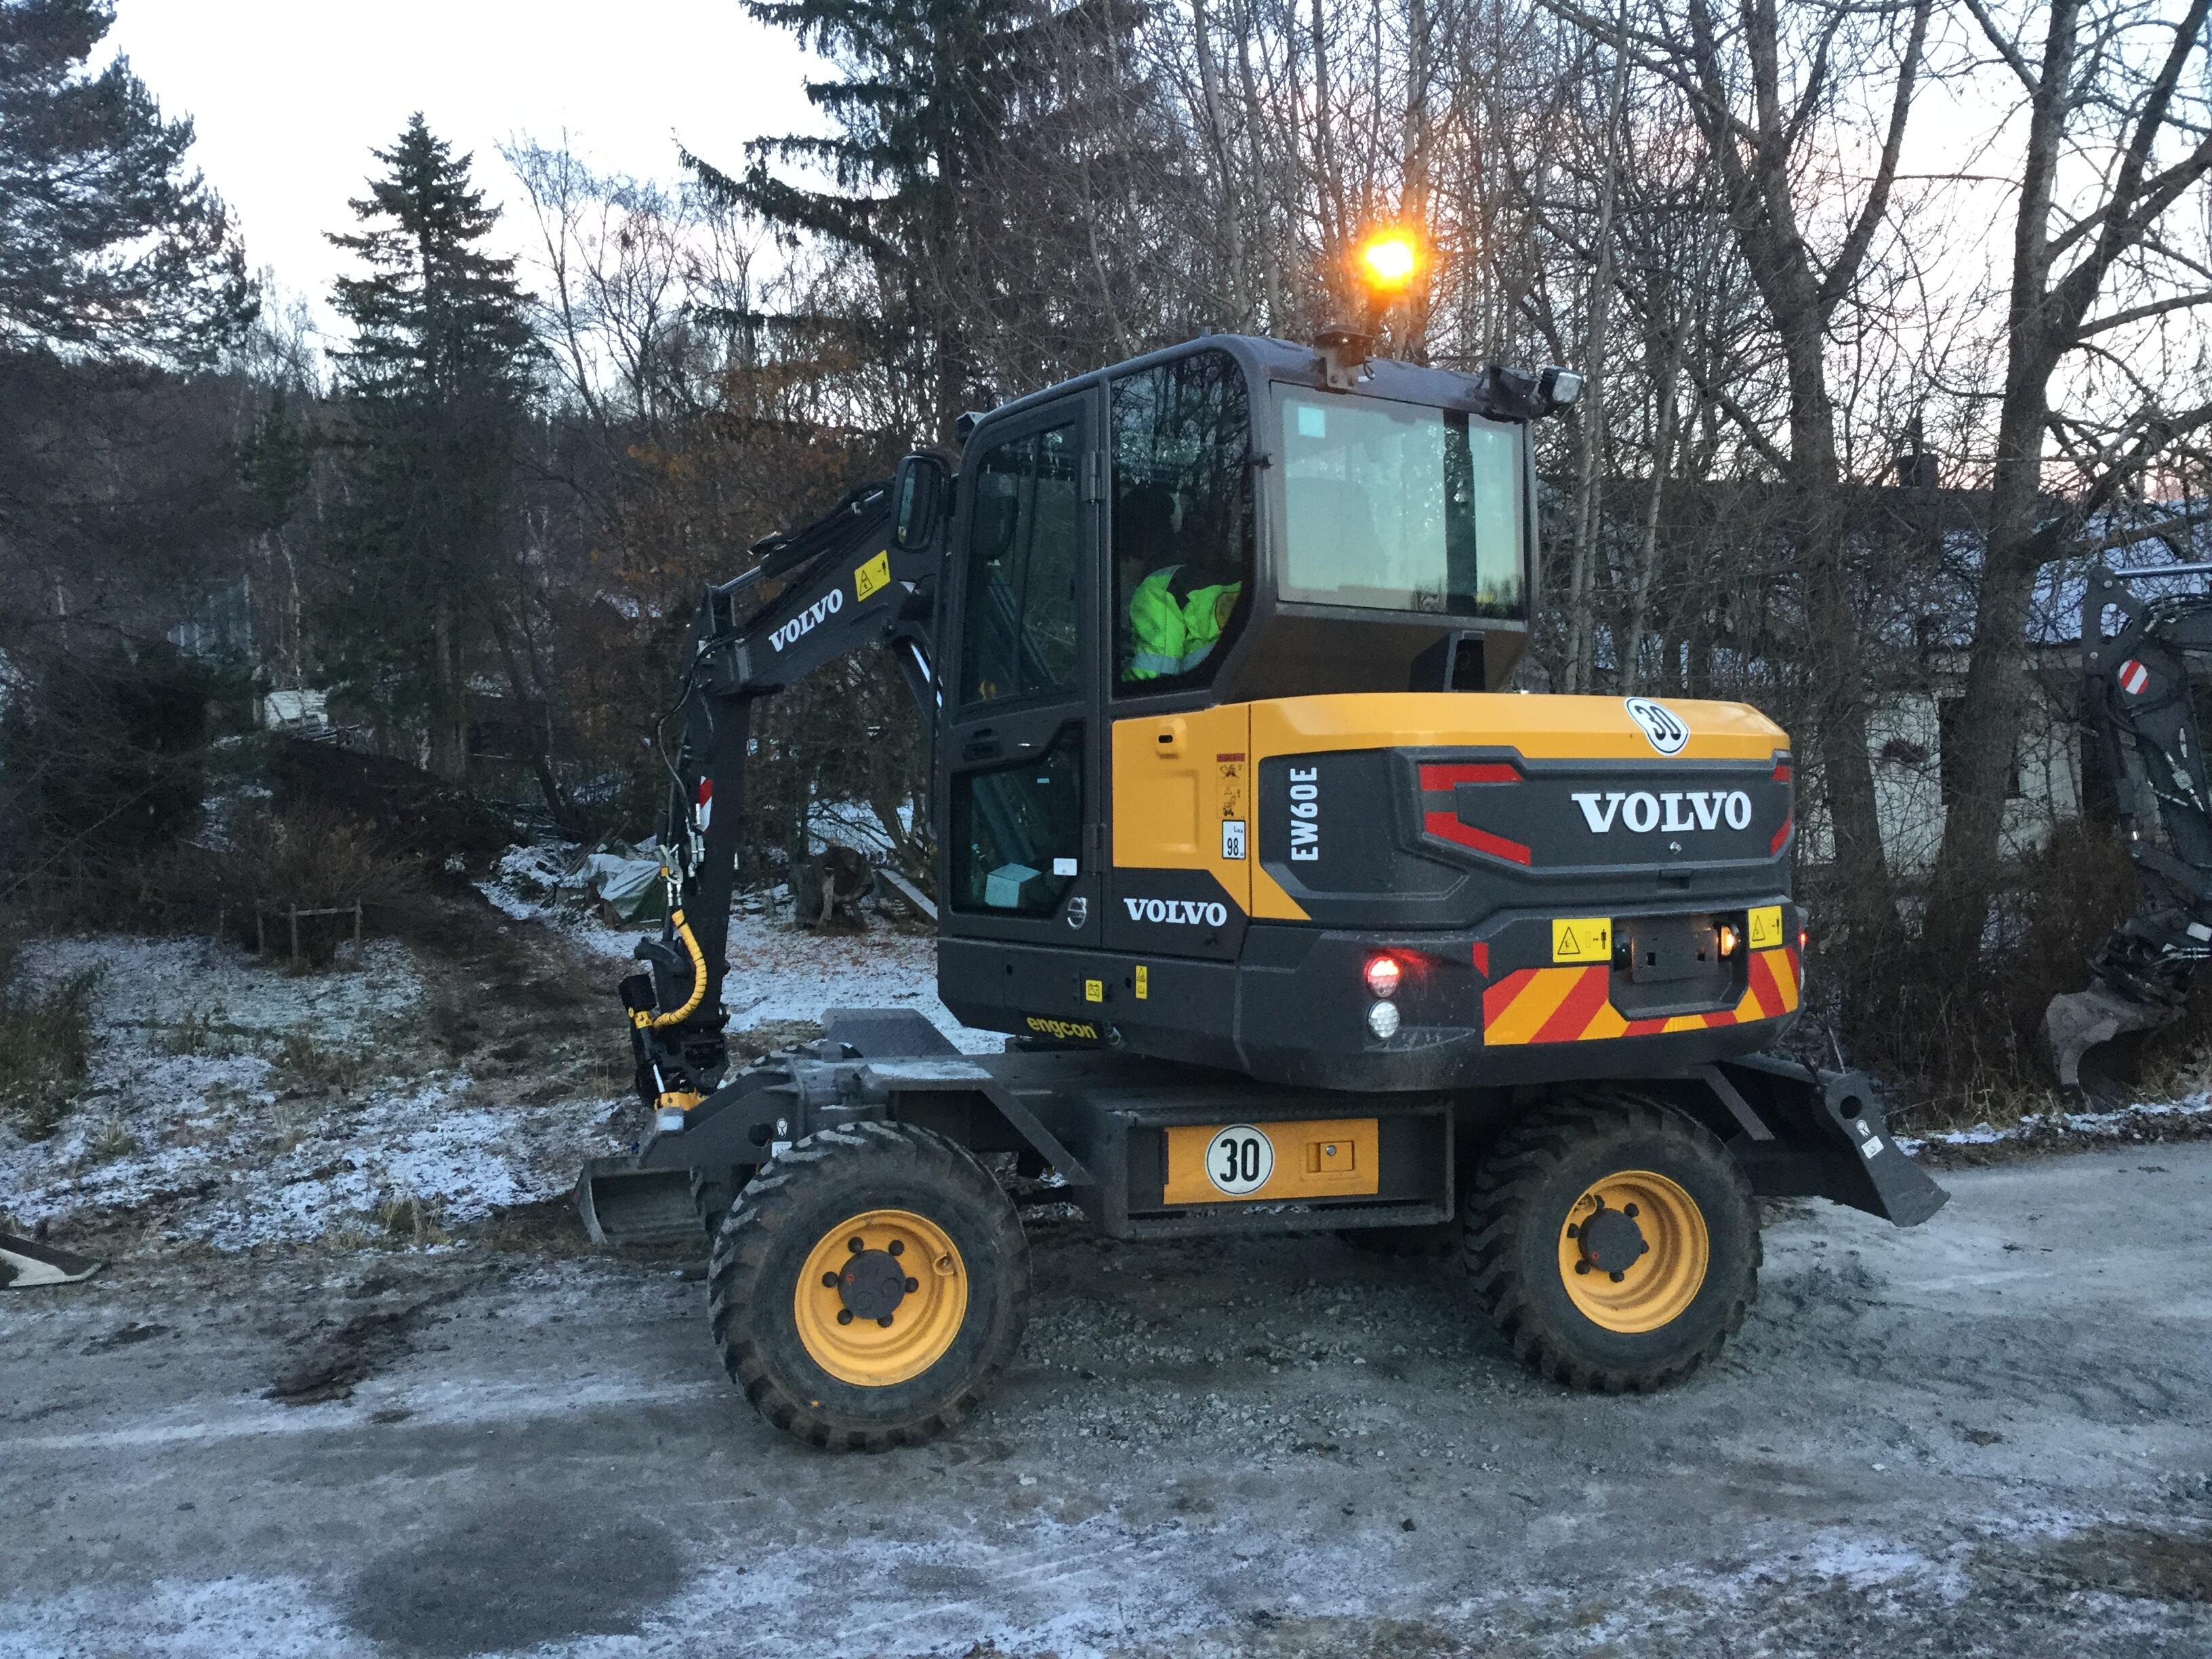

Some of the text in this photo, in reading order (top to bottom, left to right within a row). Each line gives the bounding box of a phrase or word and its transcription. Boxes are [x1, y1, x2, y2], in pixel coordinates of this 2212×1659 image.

[769, 588, 843, 652] VOLVO
[1634, 705, 1681, 741] 30
[1290, 767, 1318, 861] EW60E
[1571, 791, 1752, 833] VOLVO
[1227, 837, 1239, 856] 98
[1123, 898, 1227, 926] VOLVO
[1026, 1017, 1098, 1039] engcon
[1219, 1138, 1260, 1183] 30
